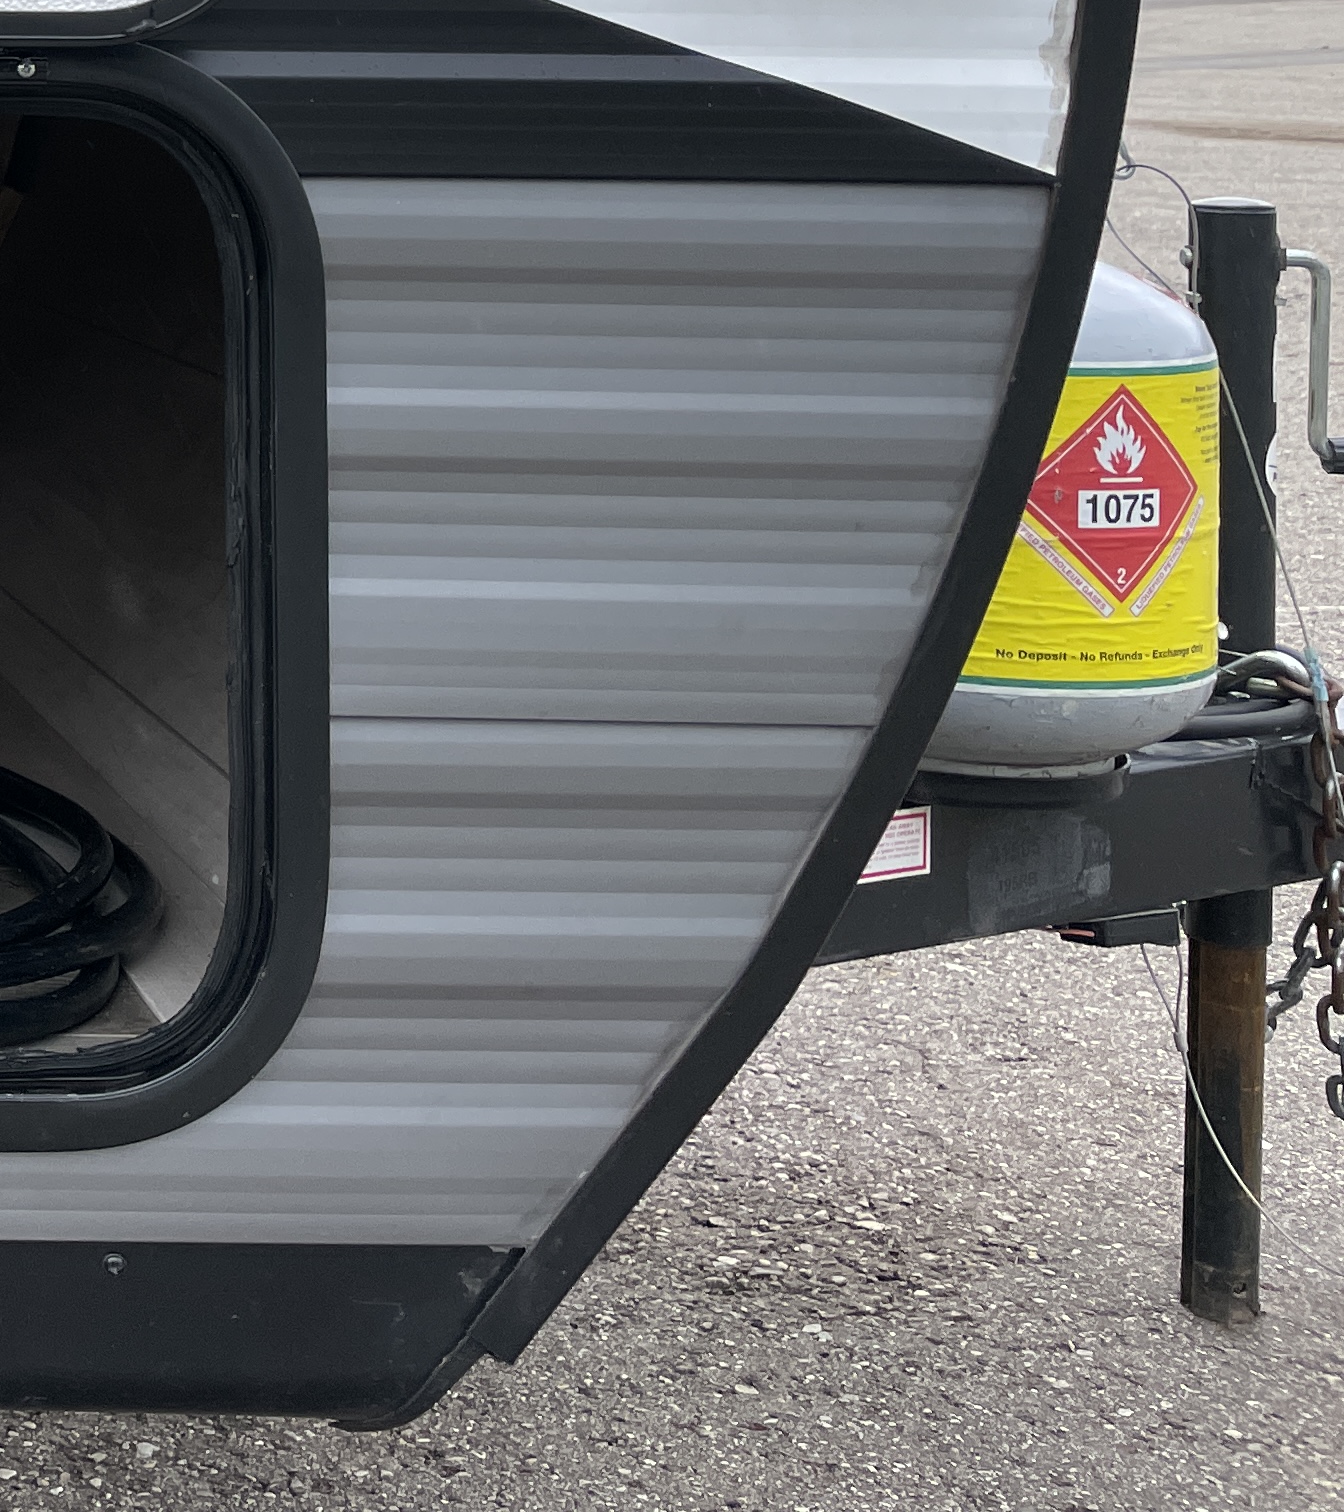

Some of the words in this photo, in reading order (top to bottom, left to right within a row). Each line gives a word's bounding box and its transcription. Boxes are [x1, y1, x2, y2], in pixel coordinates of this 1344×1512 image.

[1086, 494, 1154, 523] 1075
[1117, 568, 1126, 584] 2
[1082, 585, 1107, 610] GASES
[996, 649, 1013, 659] No
[1018, 650, 1067, 662] Deposit
[1080, 652, 1096, 662] No
[1100, 651, 1143, 662] Refunds
[1152, 647, 1189, 659] Exchange
